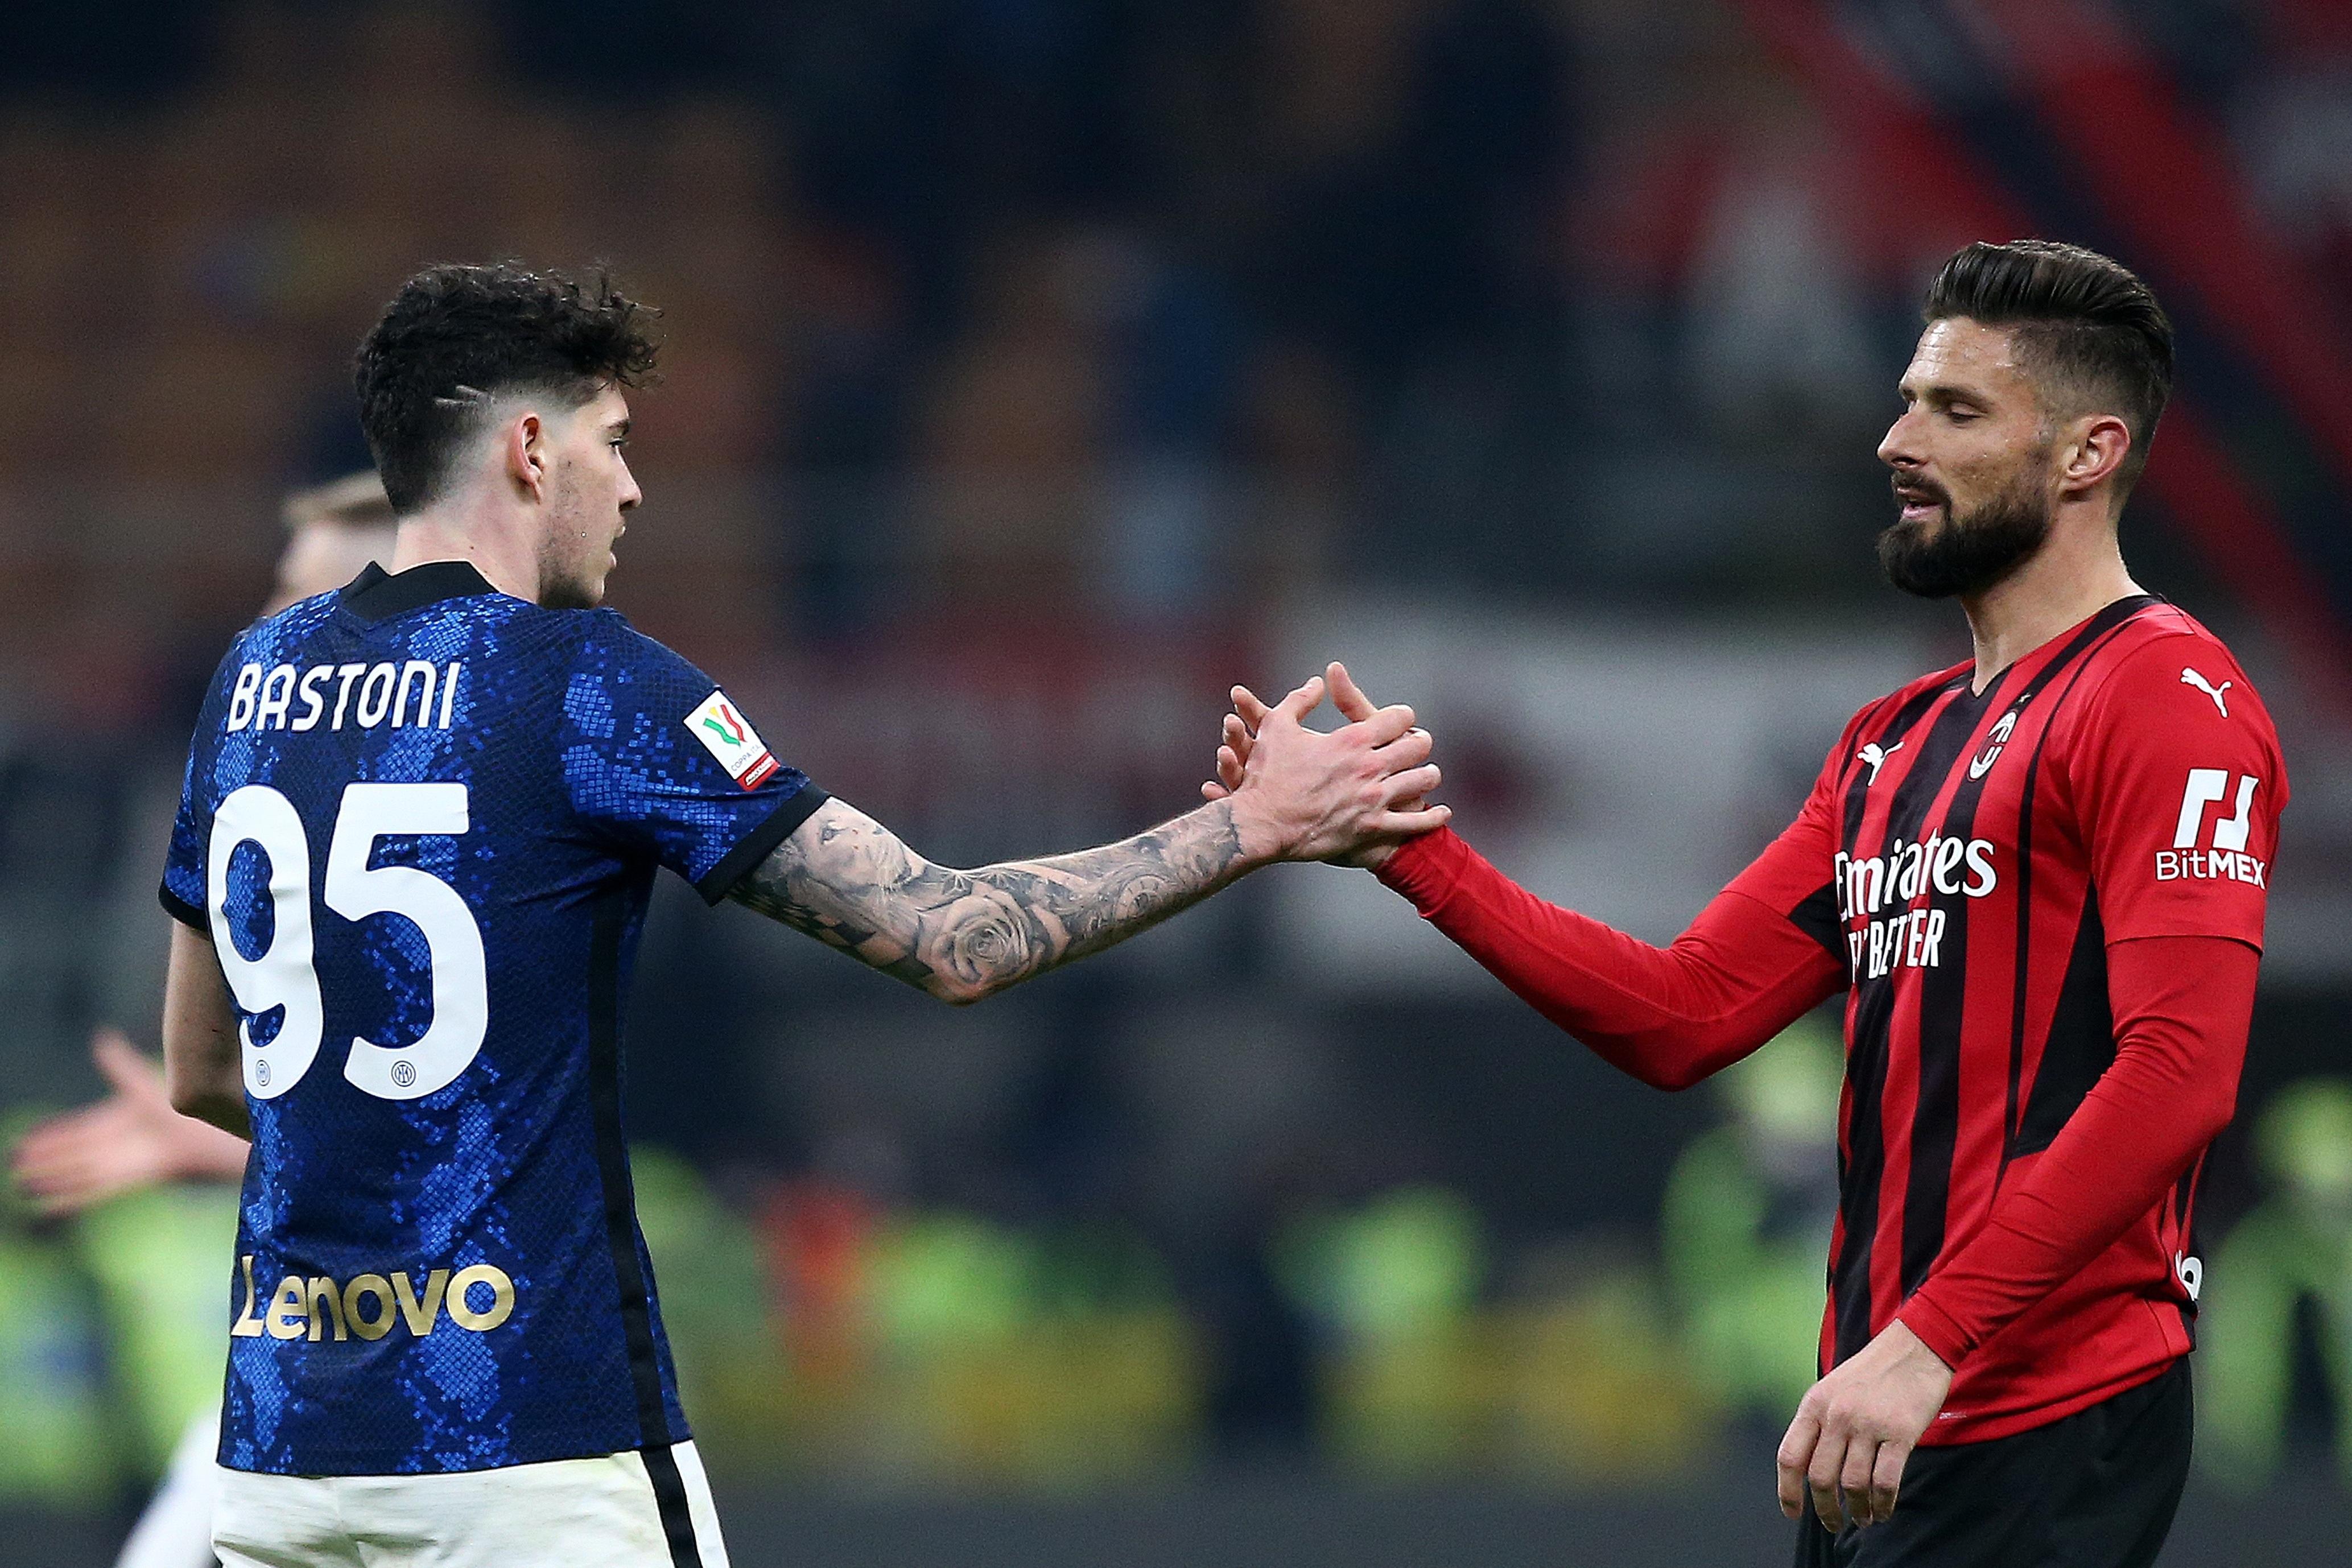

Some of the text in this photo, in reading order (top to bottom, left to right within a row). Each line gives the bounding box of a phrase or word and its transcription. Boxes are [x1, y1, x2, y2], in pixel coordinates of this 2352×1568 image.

[227, 661, 461, 732] BASTONI
[731, 752, 752, 771] COPPA
[2156, 850, 2265, 890] BitMEX
[208, 783, 488, 1100] 95
[1868, 909, 1946, 979] BETER
[231, 1256, 515, 1341] Lenovo
